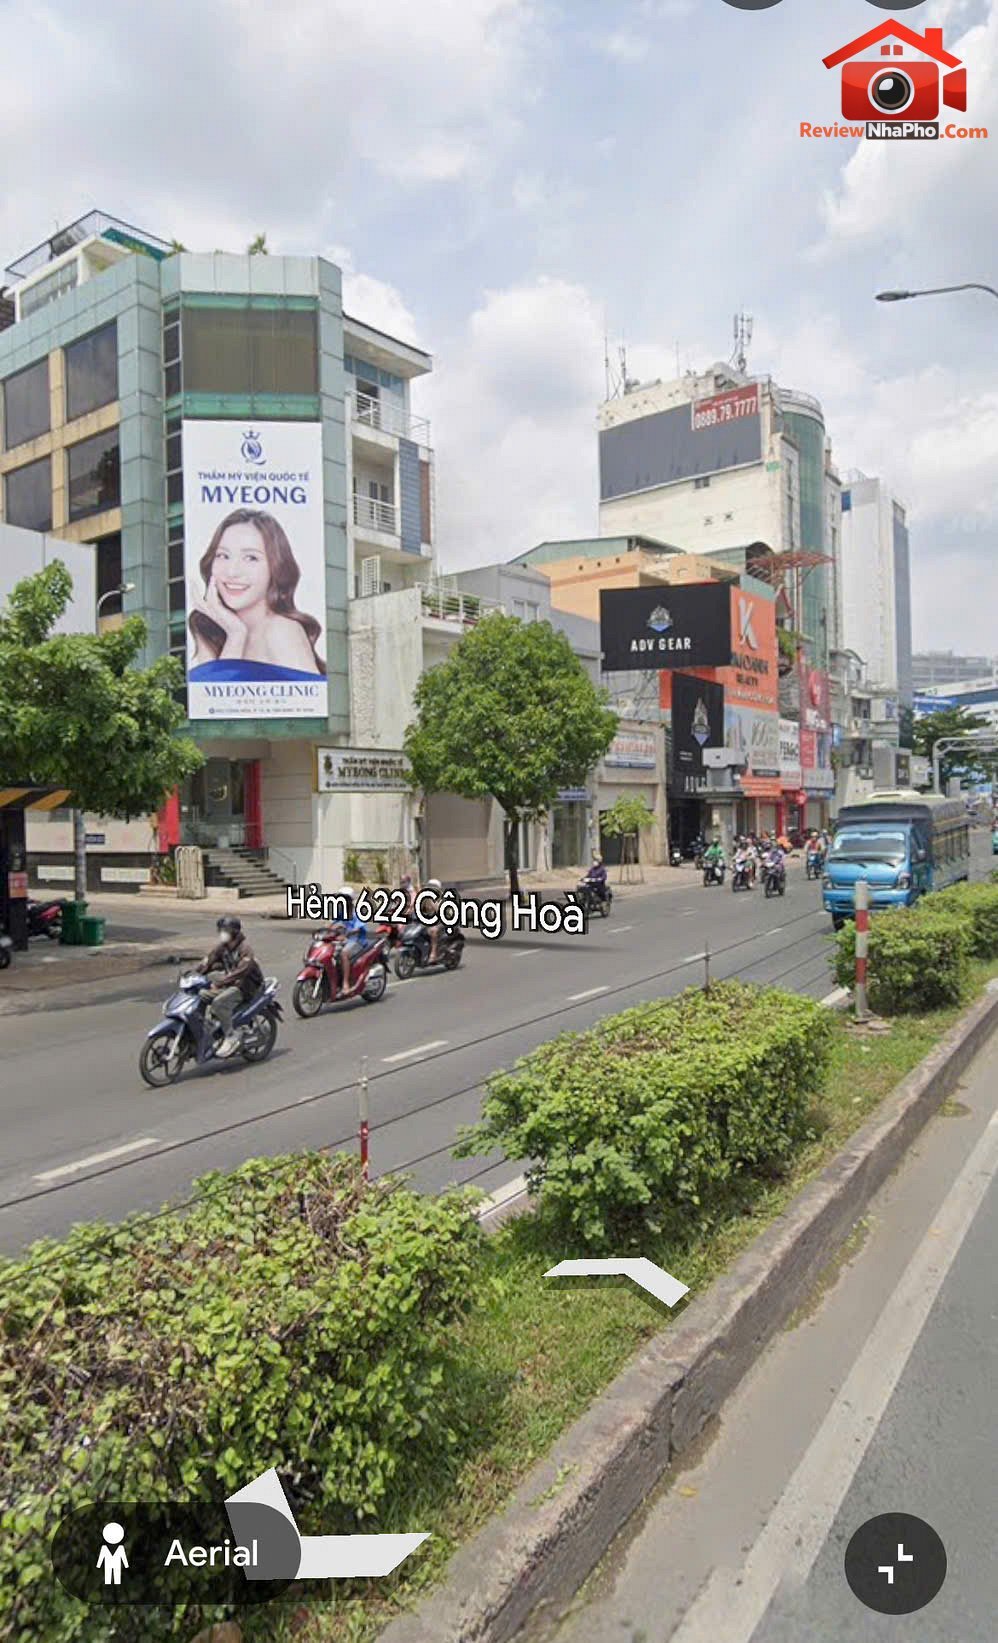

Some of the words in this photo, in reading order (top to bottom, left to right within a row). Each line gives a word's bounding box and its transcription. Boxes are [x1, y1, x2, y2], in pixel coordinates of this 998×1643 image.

[244, 471, 267, 483] VIỆN
[201, 485, 307, 504] MYEONG
[630, 638, 655, 653] ADV
[658, 637, 692, 651] GEAR
[203, 685, 266, 697] MYEONG
[269, 685, 319, 697] CLINIC
